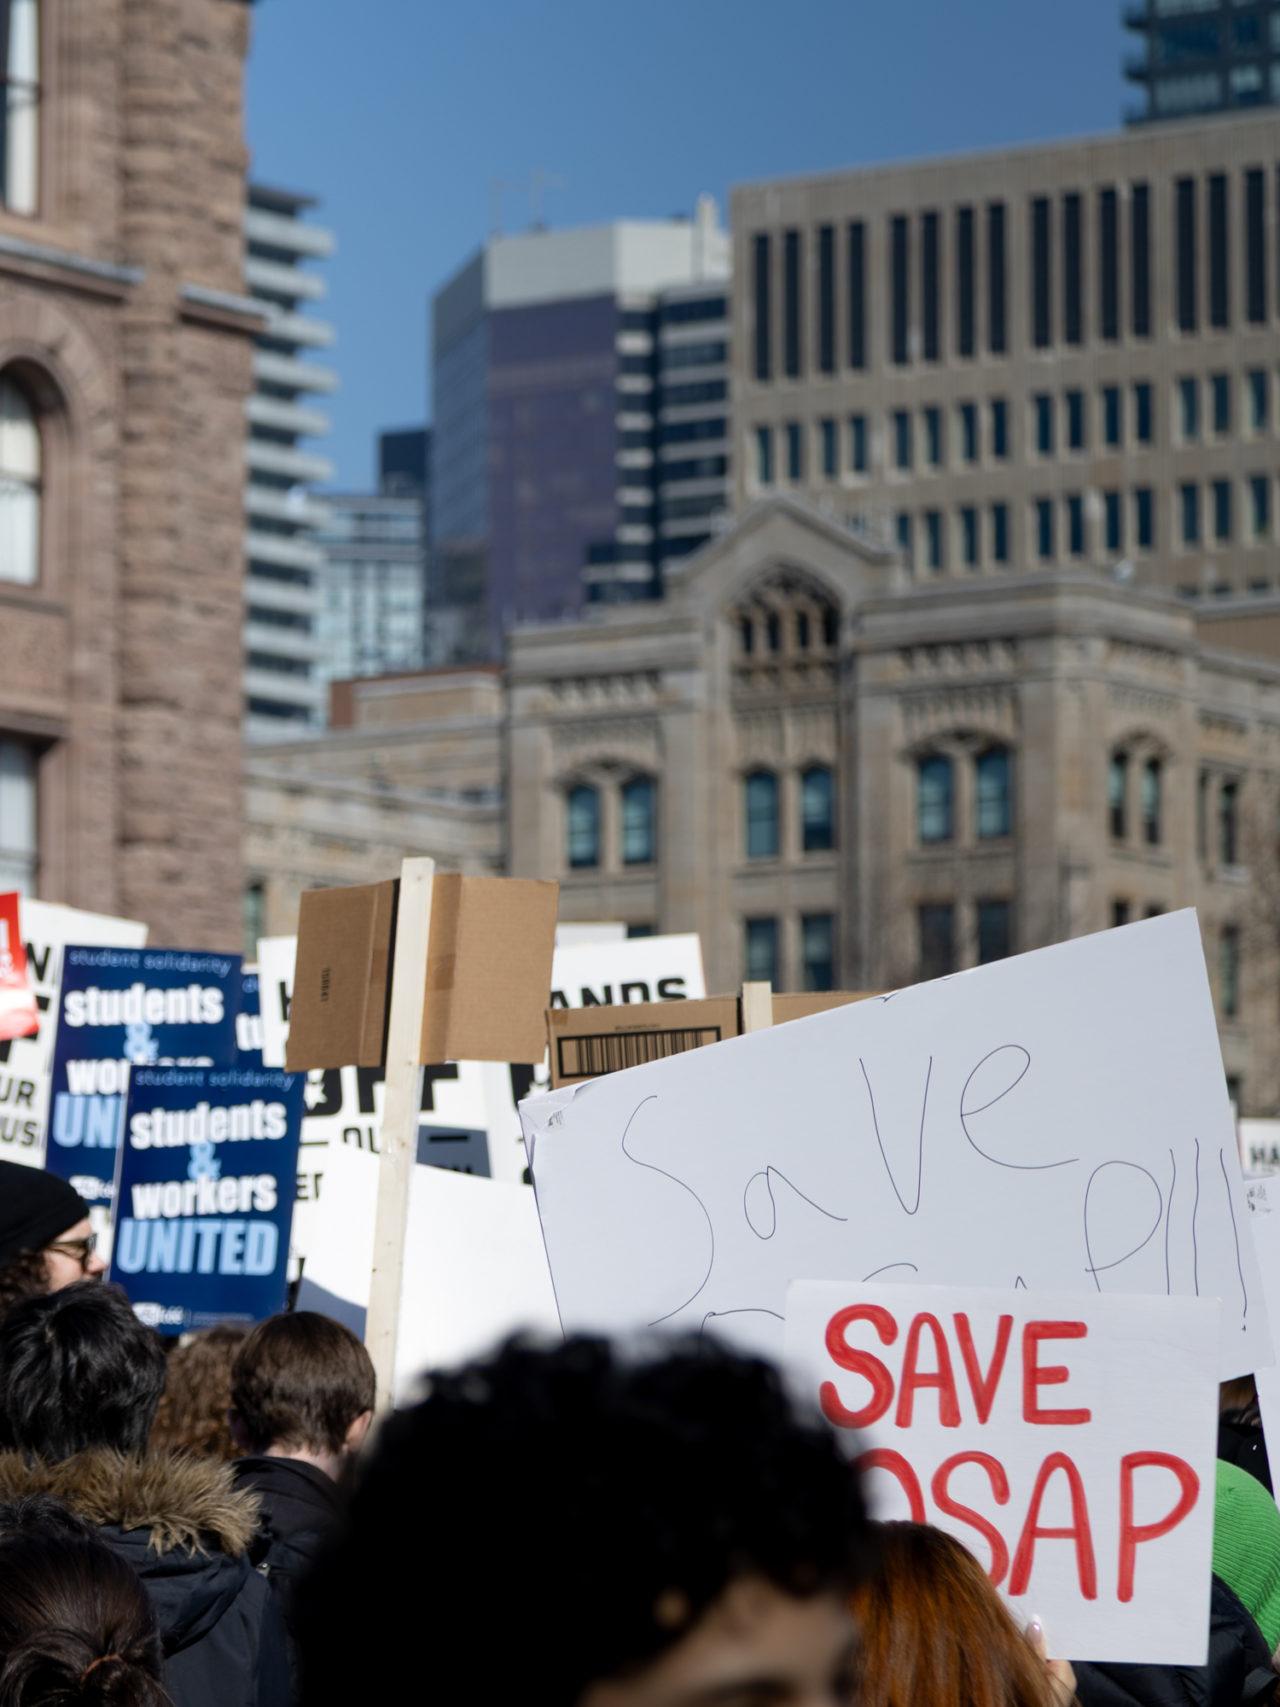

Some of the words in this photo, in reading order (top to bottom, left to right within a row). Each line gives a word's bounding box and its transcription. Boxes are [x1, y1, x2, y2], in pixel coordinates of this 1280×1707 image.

[69, 949, 140, 968] student
[143, 951, 233, 978] solidarity
[64, 982, 225, 1028] students
[551, 978, 688, 1009] ANDS
[135, 1068, 205, 1088] student
[208, 1069, 296, 1093] solidarity
[129, 1100, 288, 1150] students
[131, 1174, 278, 1220] workers
[621, 1044, 1080, 1327] Save
[116, 1217, 280, 1276] UNITED
[819, 1303, 1092, 1430] SAVE
